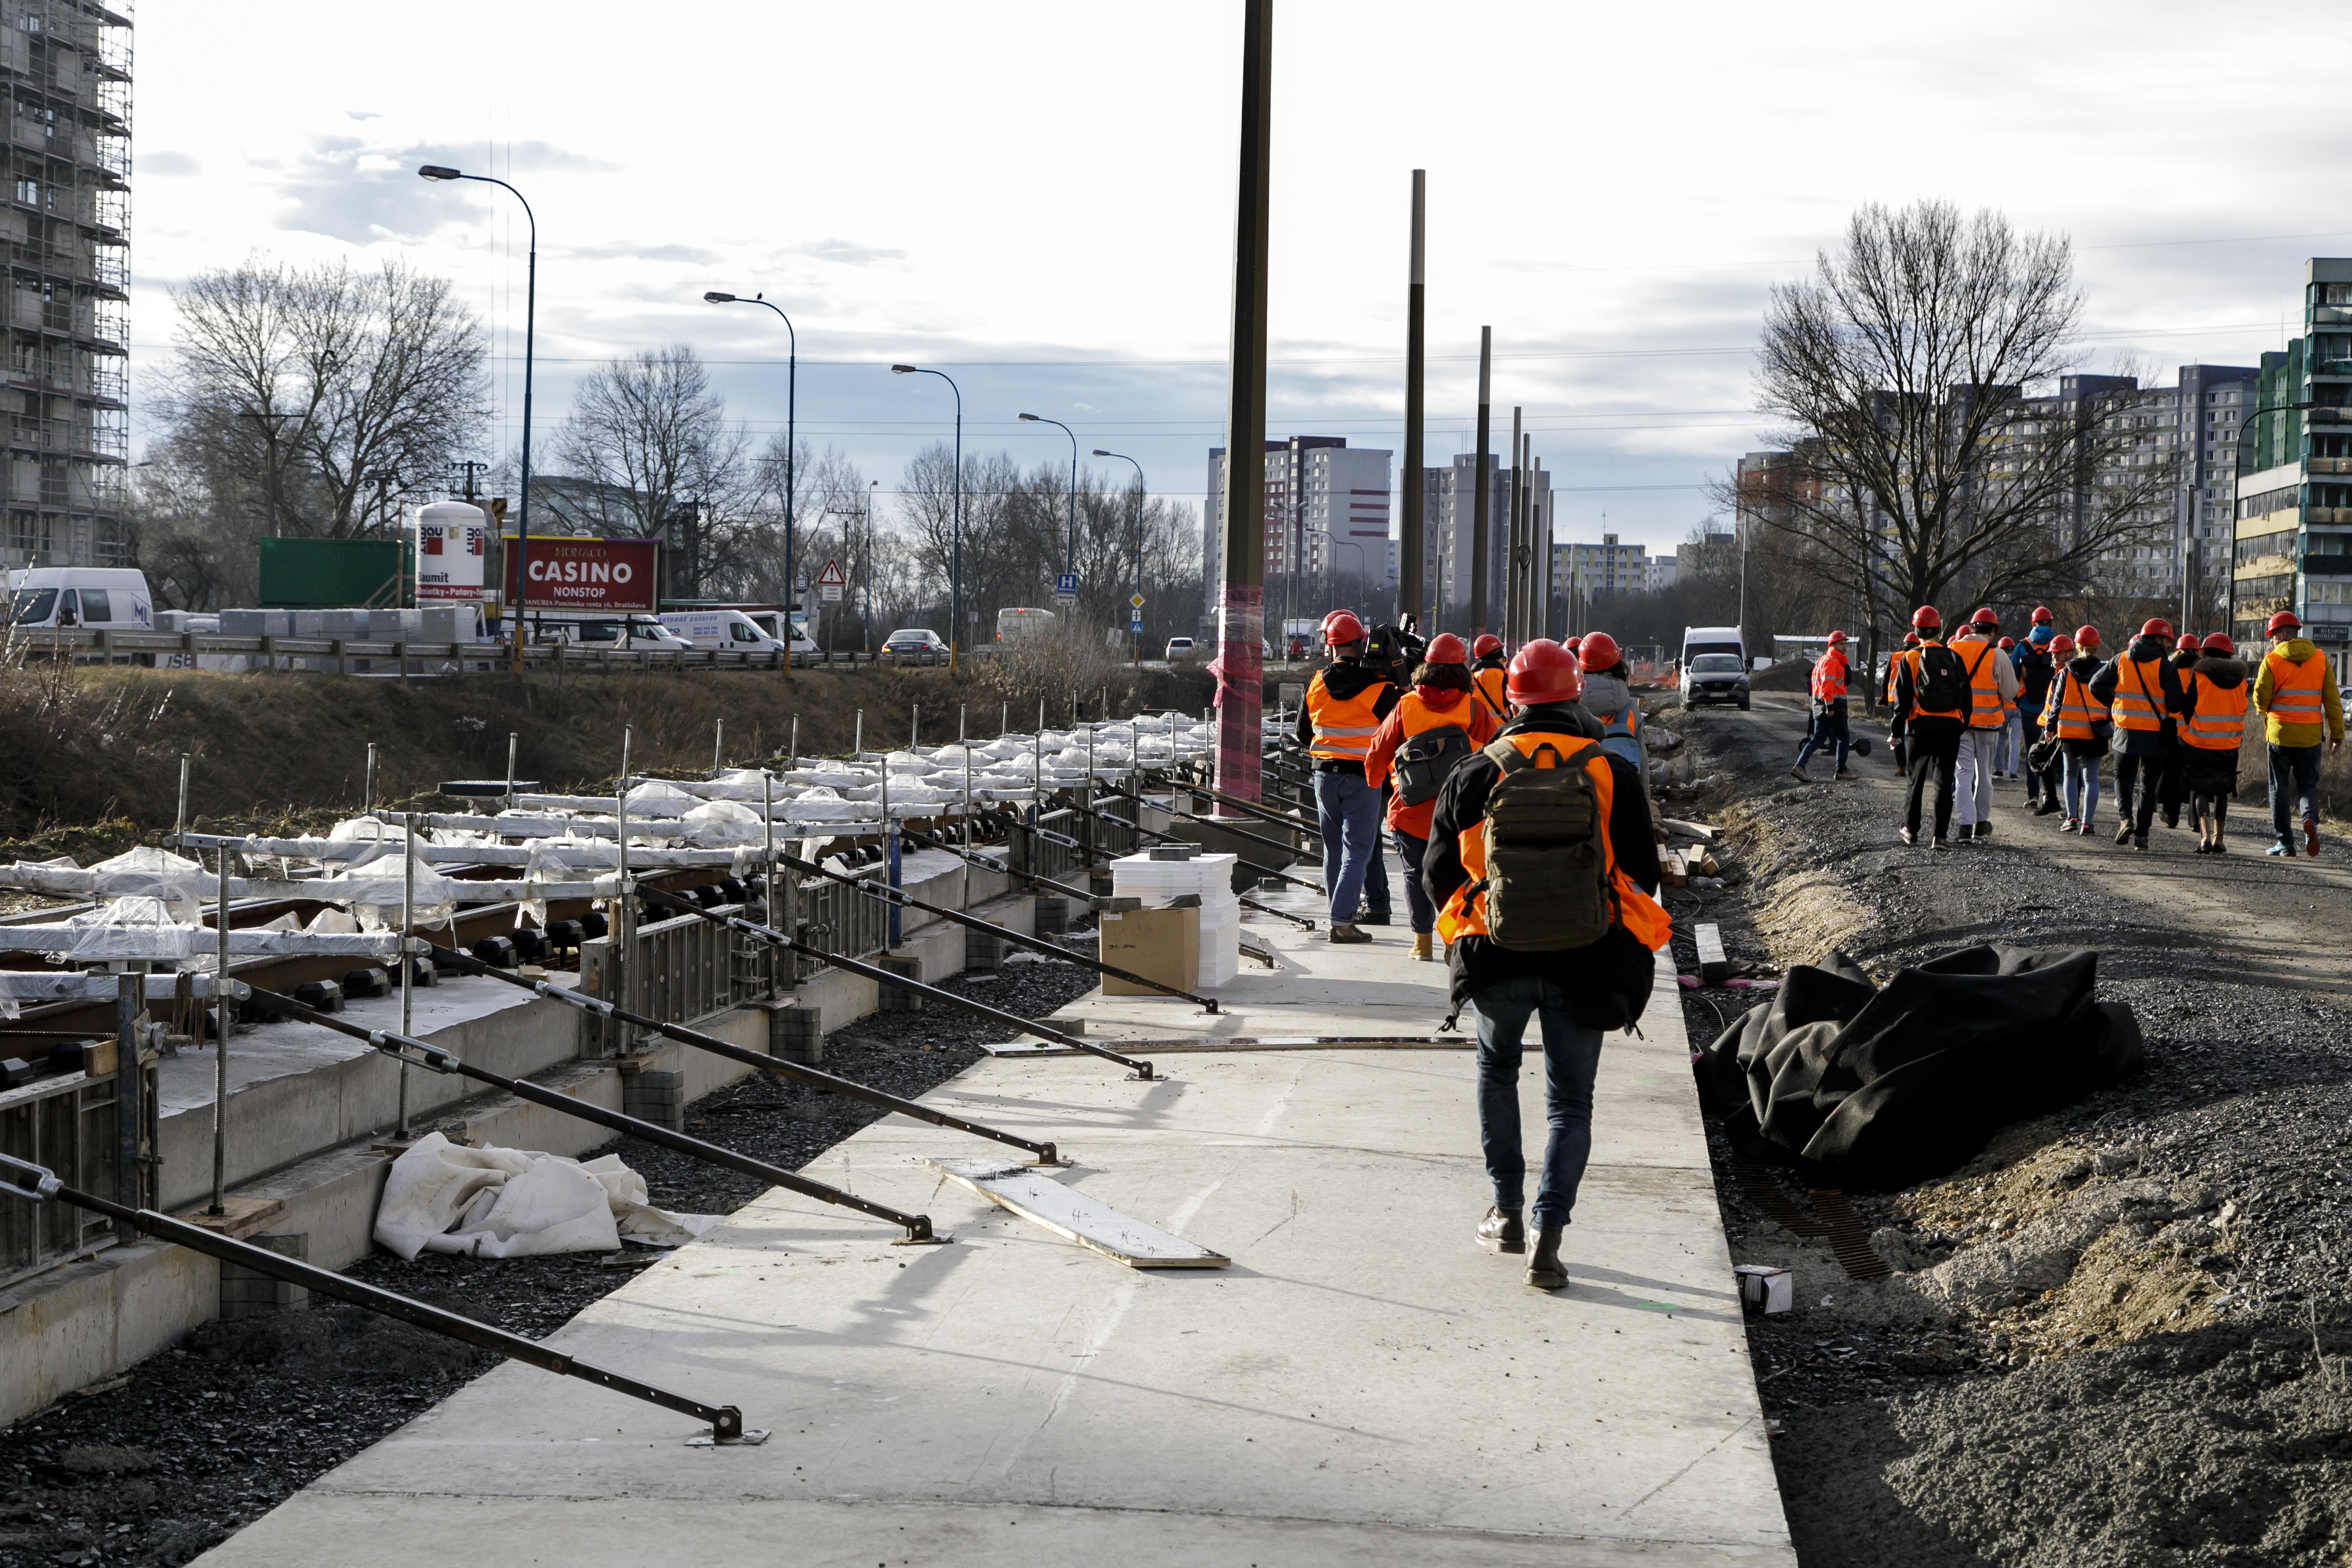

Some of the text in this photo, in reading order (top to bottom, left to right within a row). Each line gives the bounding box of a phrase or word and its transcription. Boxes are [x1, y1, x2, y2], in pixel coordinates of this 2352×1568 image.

[555, 547, 606, 558] MONACO
[529, 560, 632, 583] CASINO
[1062, 576, 1072, 587] H
[553, 587, 605, 598] NONSTOP
